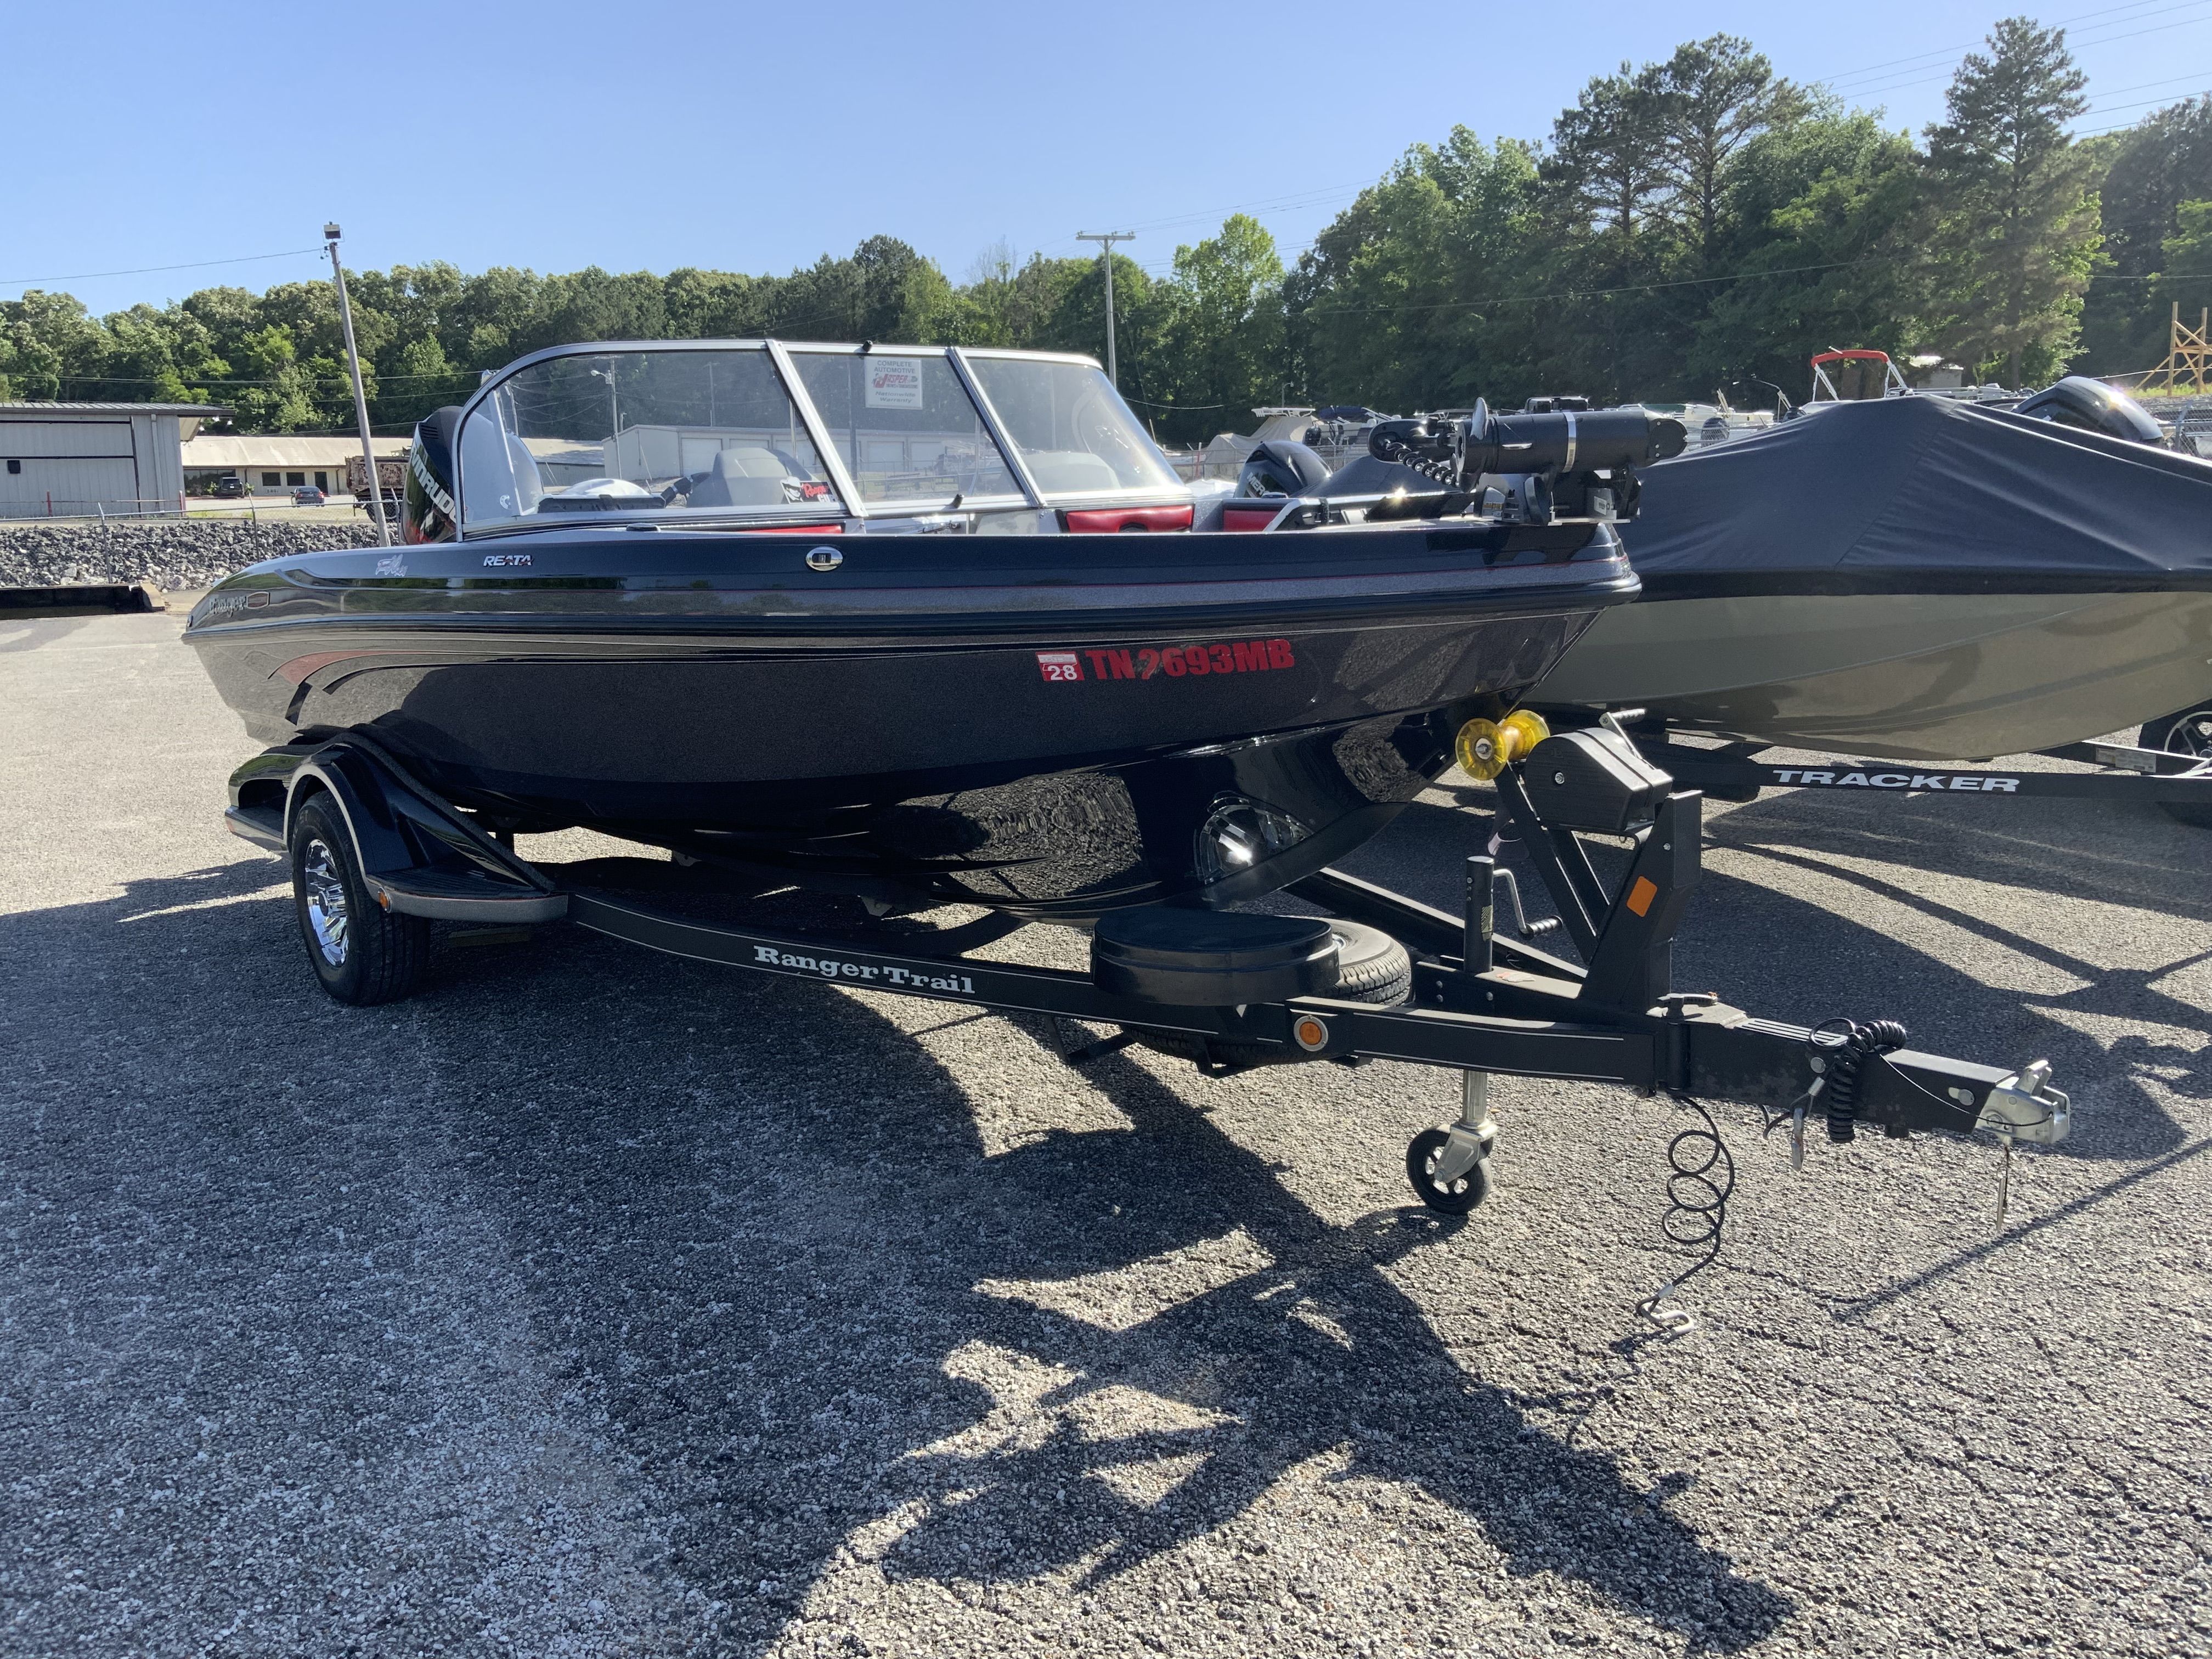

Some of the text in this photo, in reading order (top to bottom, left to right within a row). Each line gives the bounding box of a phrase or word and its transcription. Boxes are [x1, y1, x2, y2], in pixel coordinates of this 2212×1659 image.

[873, 374, 909, 388] JASPER
[483, 555, 534, 567] REATA
[1047, 664, 1077, 680] 28
[1773, 770, 2020, 792] TRACKER
[753, 945, 975, 994] Ranger Trail
